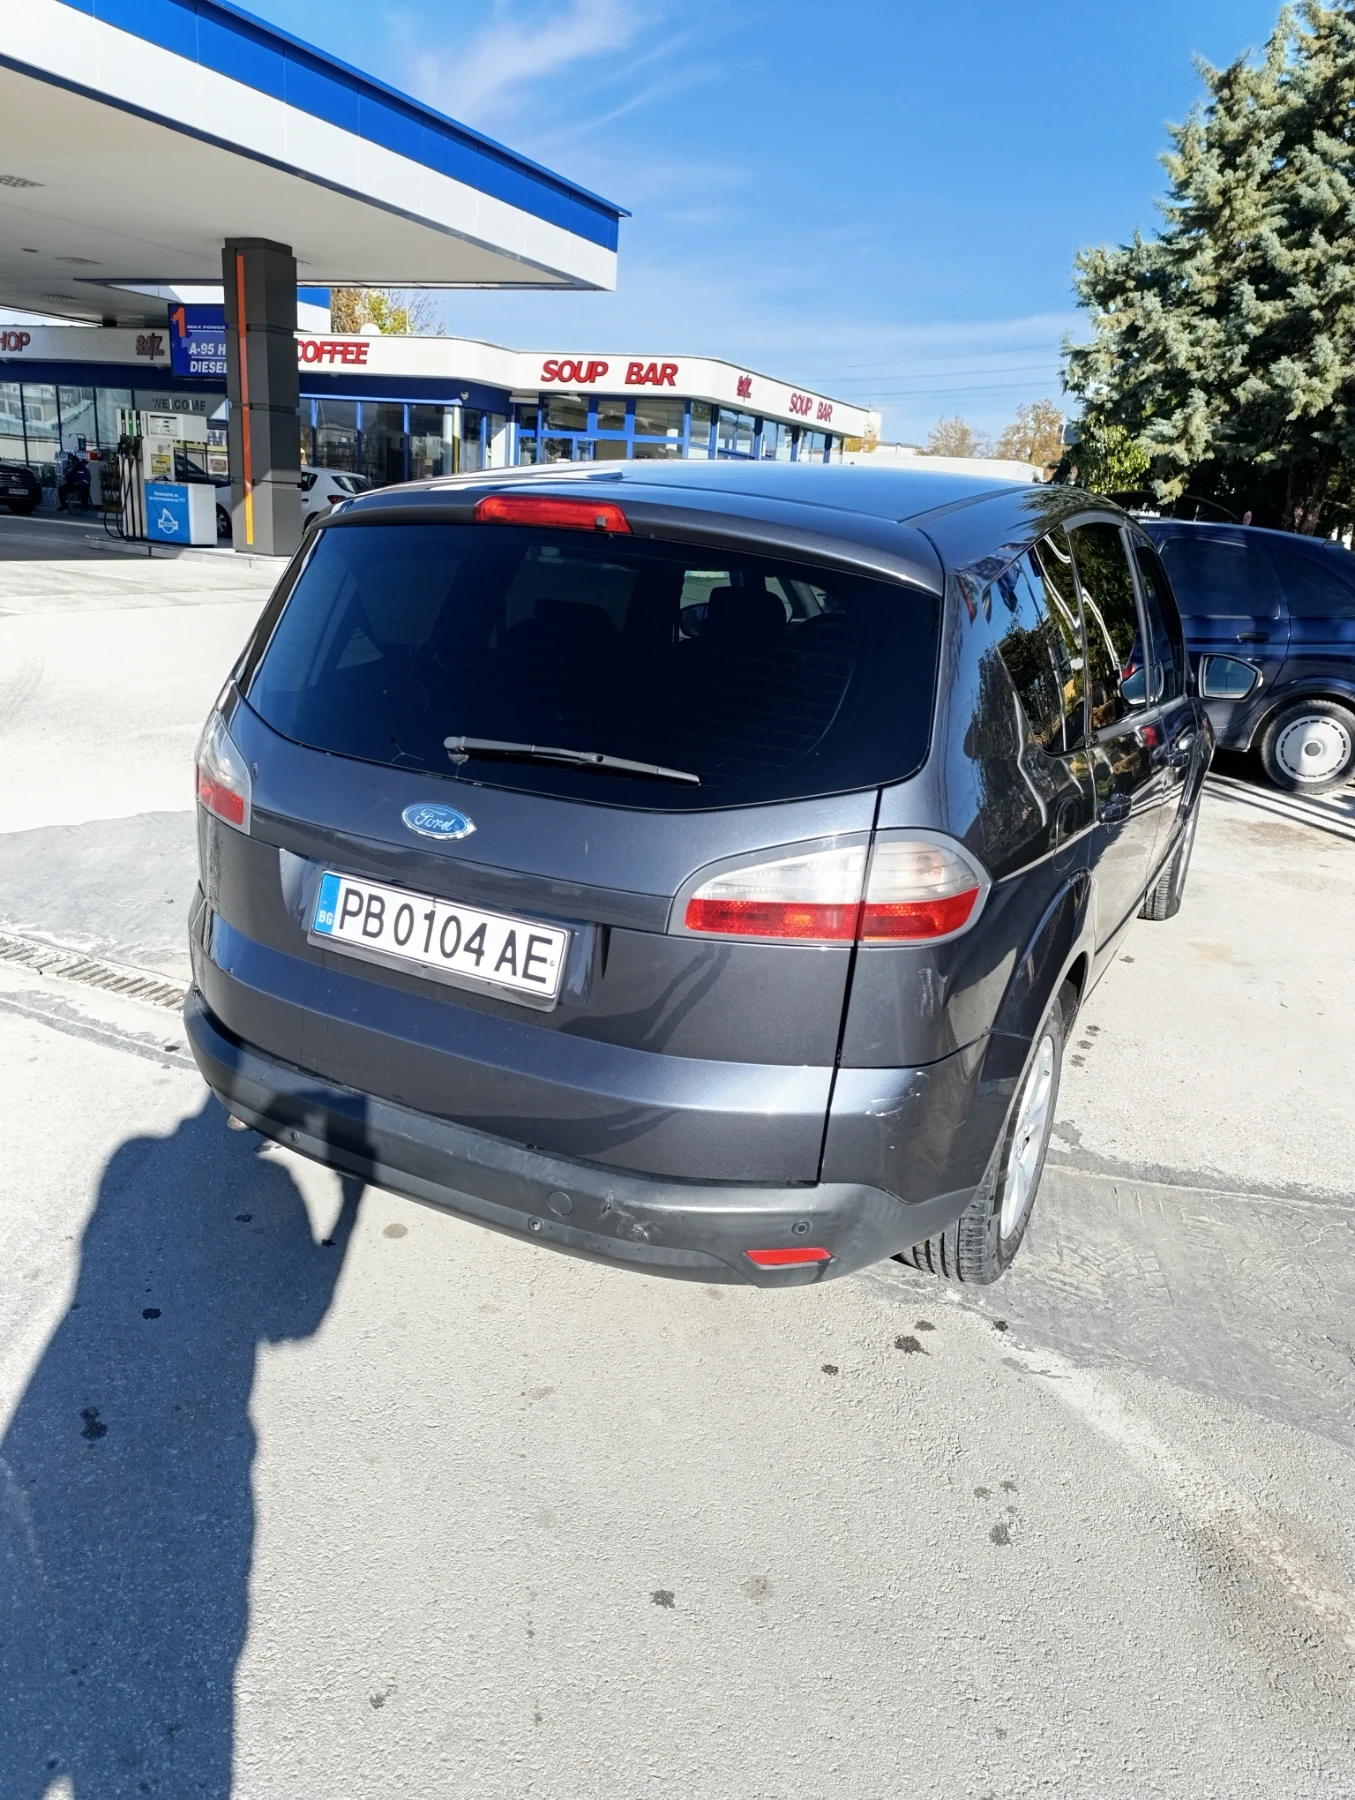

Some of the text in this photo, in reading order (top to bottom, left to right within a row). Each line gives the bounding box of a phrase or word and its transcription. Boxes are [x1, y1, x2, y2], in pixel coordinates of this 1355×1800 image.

[540, 359, 679, 387] SOUP BAR
[789, 392, 834, 423] SOUP BAR
[414, 808, 457, 832] Ford
[318, 909, 334, 926] BG
[338, 887, 554, 984] PB 0104 AE
